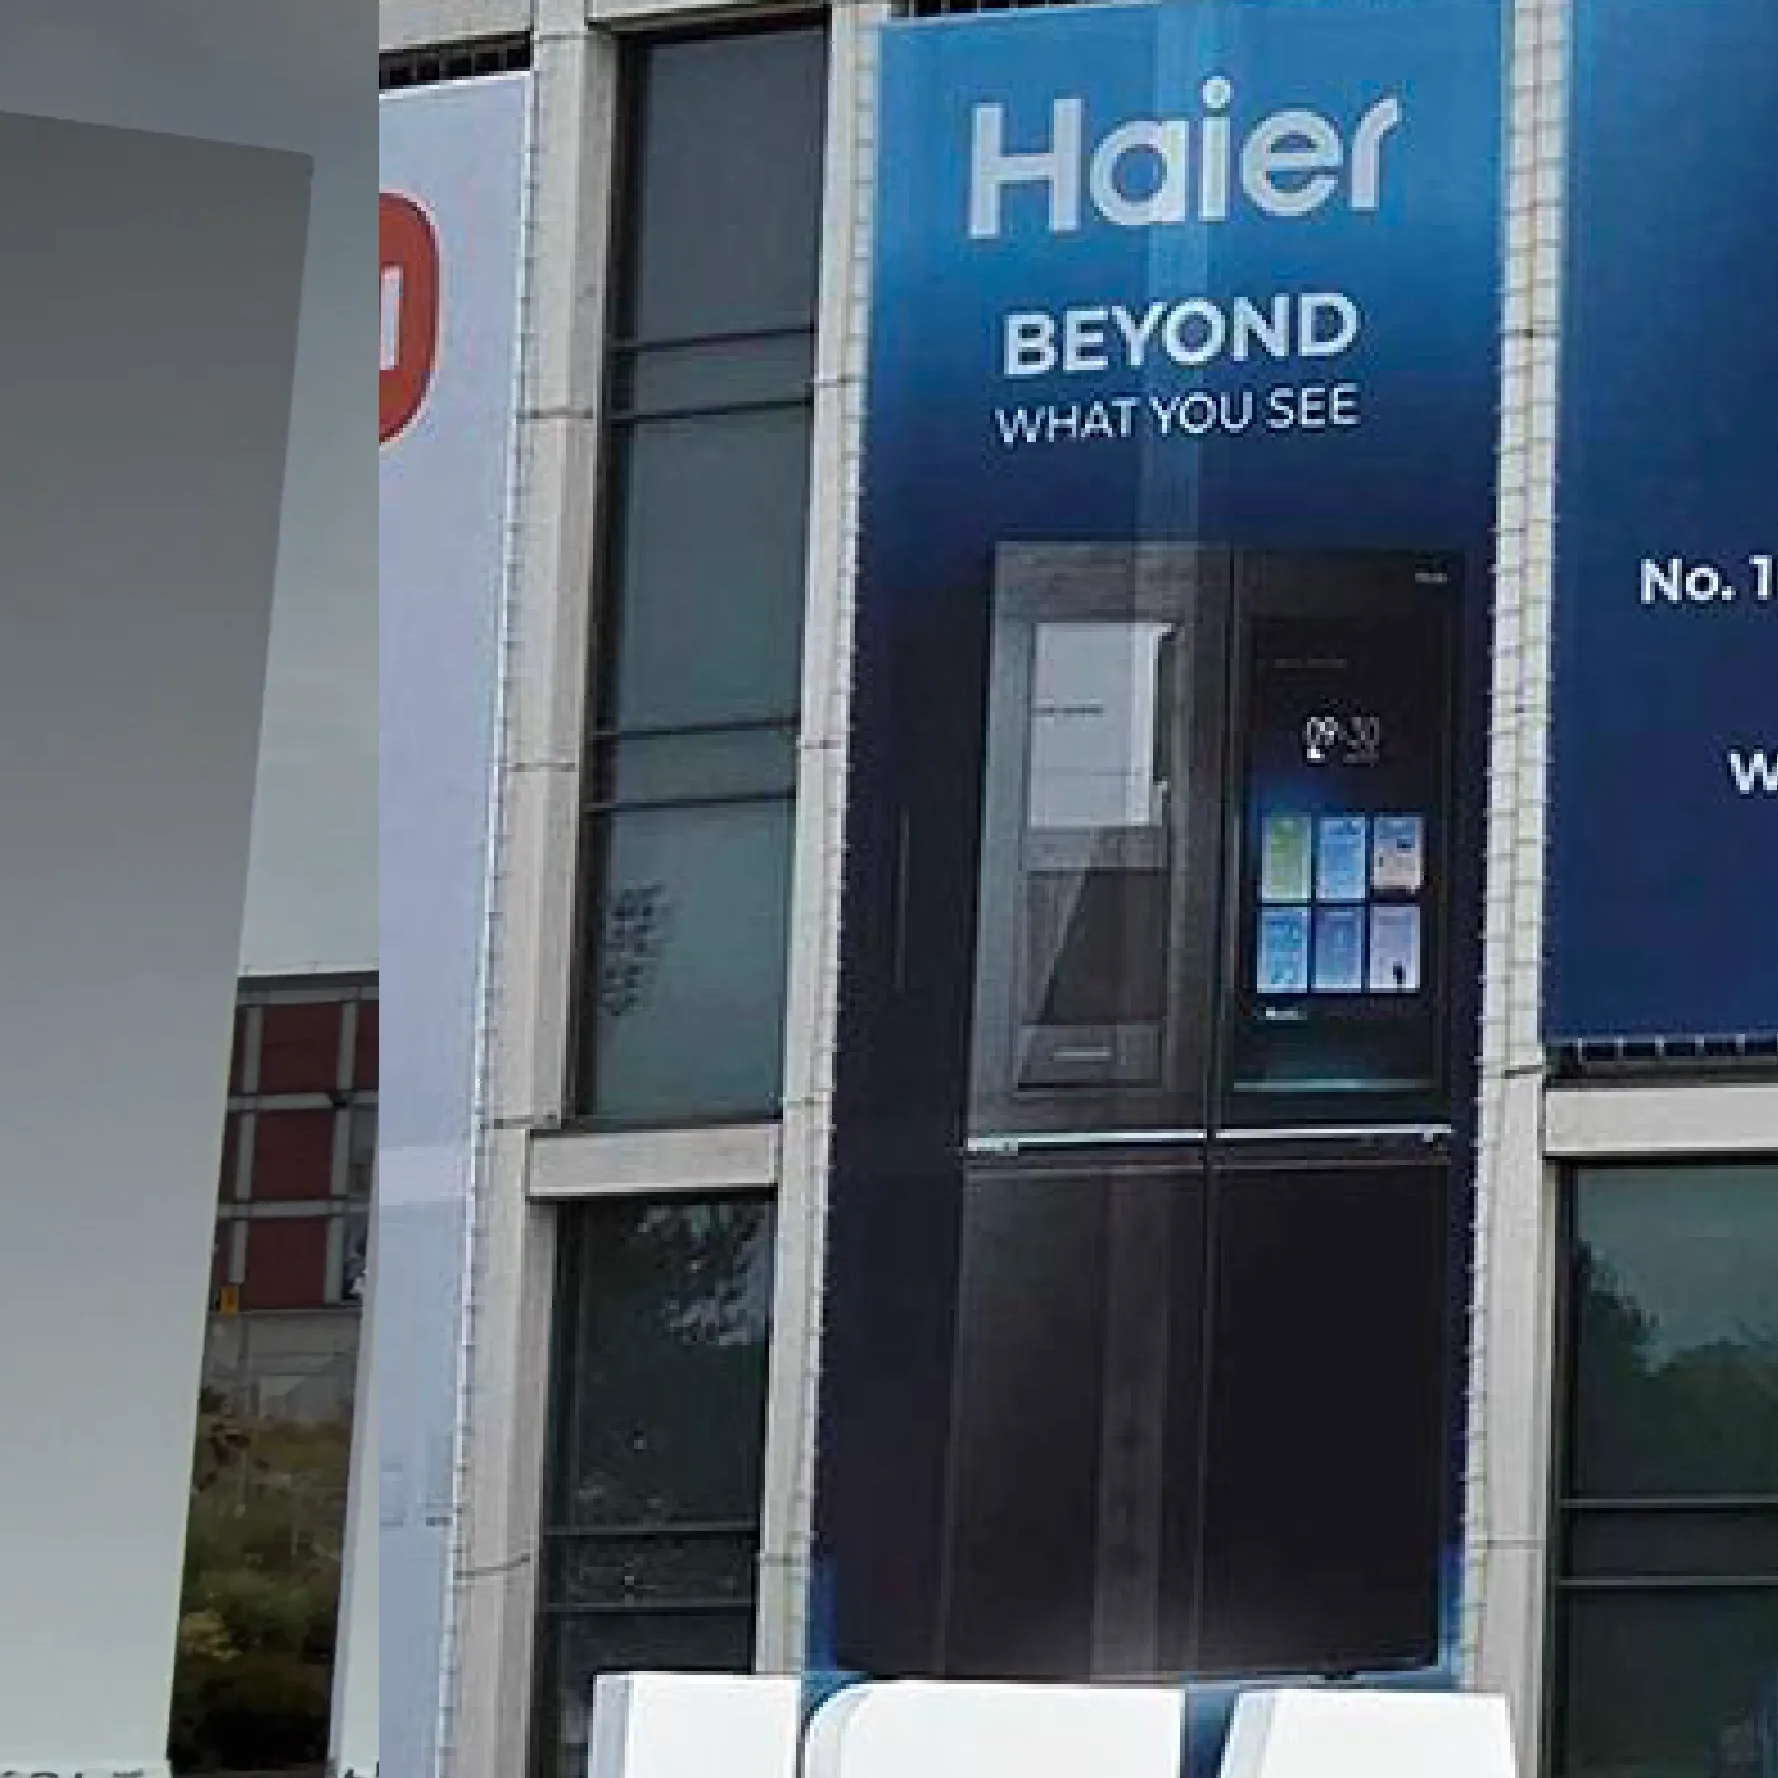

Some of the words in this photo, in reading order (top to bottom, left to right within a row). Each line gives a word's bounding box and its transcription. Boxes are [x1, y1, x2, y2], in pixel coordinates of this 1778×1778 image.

[966, 75, 1400, 239] Haier
[1001, 291, 1360, 378] BEYOND
[994, 395, 1136, 446] WHAT
[1147, 390, 1255, 438] YOU
[1266, 384, 1360, 432] SEE
[1639, 556, 1737, 605] No.
[1749, 553, 1775, 600] 1
